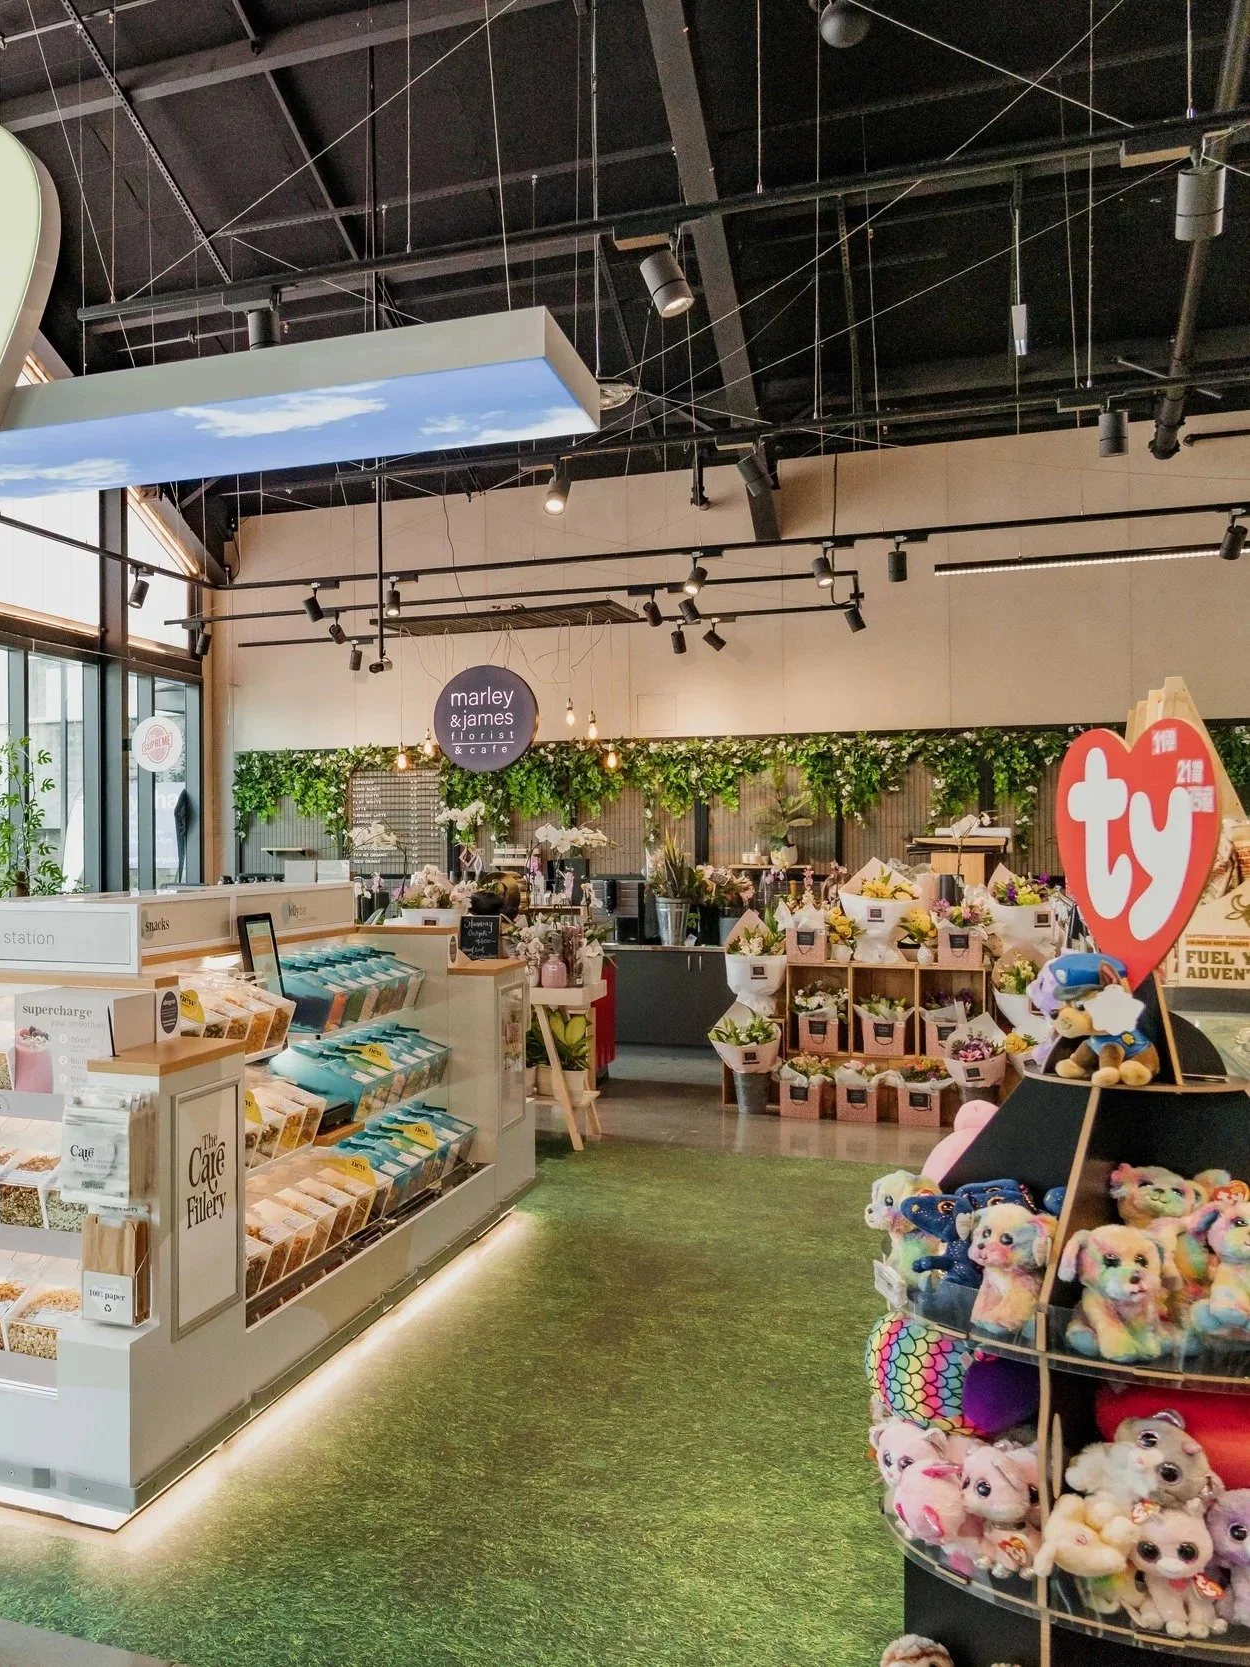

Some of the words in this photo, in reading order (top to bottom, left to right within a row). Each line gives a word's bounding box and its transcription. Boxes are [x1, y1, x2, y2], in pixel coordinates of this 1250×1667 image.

[450, 686, 514, 709] marley
[450, 710, 514, 731] &james
[143, 734, 172, 752] SUPREME
[451, 730, 514, 740] florist
[454, 746, 462, 755] &
[469, 745, 508, 754] cafe
[1067, 747, 1194, 941] ty
[145, 917, 170, 932] snacks
[4, 930, 55, 945] station
[1186, 950, 1235, 966] FUEL
[180, 994, 196, 1006] new
[22, 1005, 93, 1019] supercharge
[70, 1075, 88, 1083] base
[202, 1132, 218, 1151] The
[70, 1144, 94, 1162] Care
[189, 1141, 226, 1194] Care
[187, 1190, 227, 1230] Fillery
[104, 1293, 125, 1301] paper
